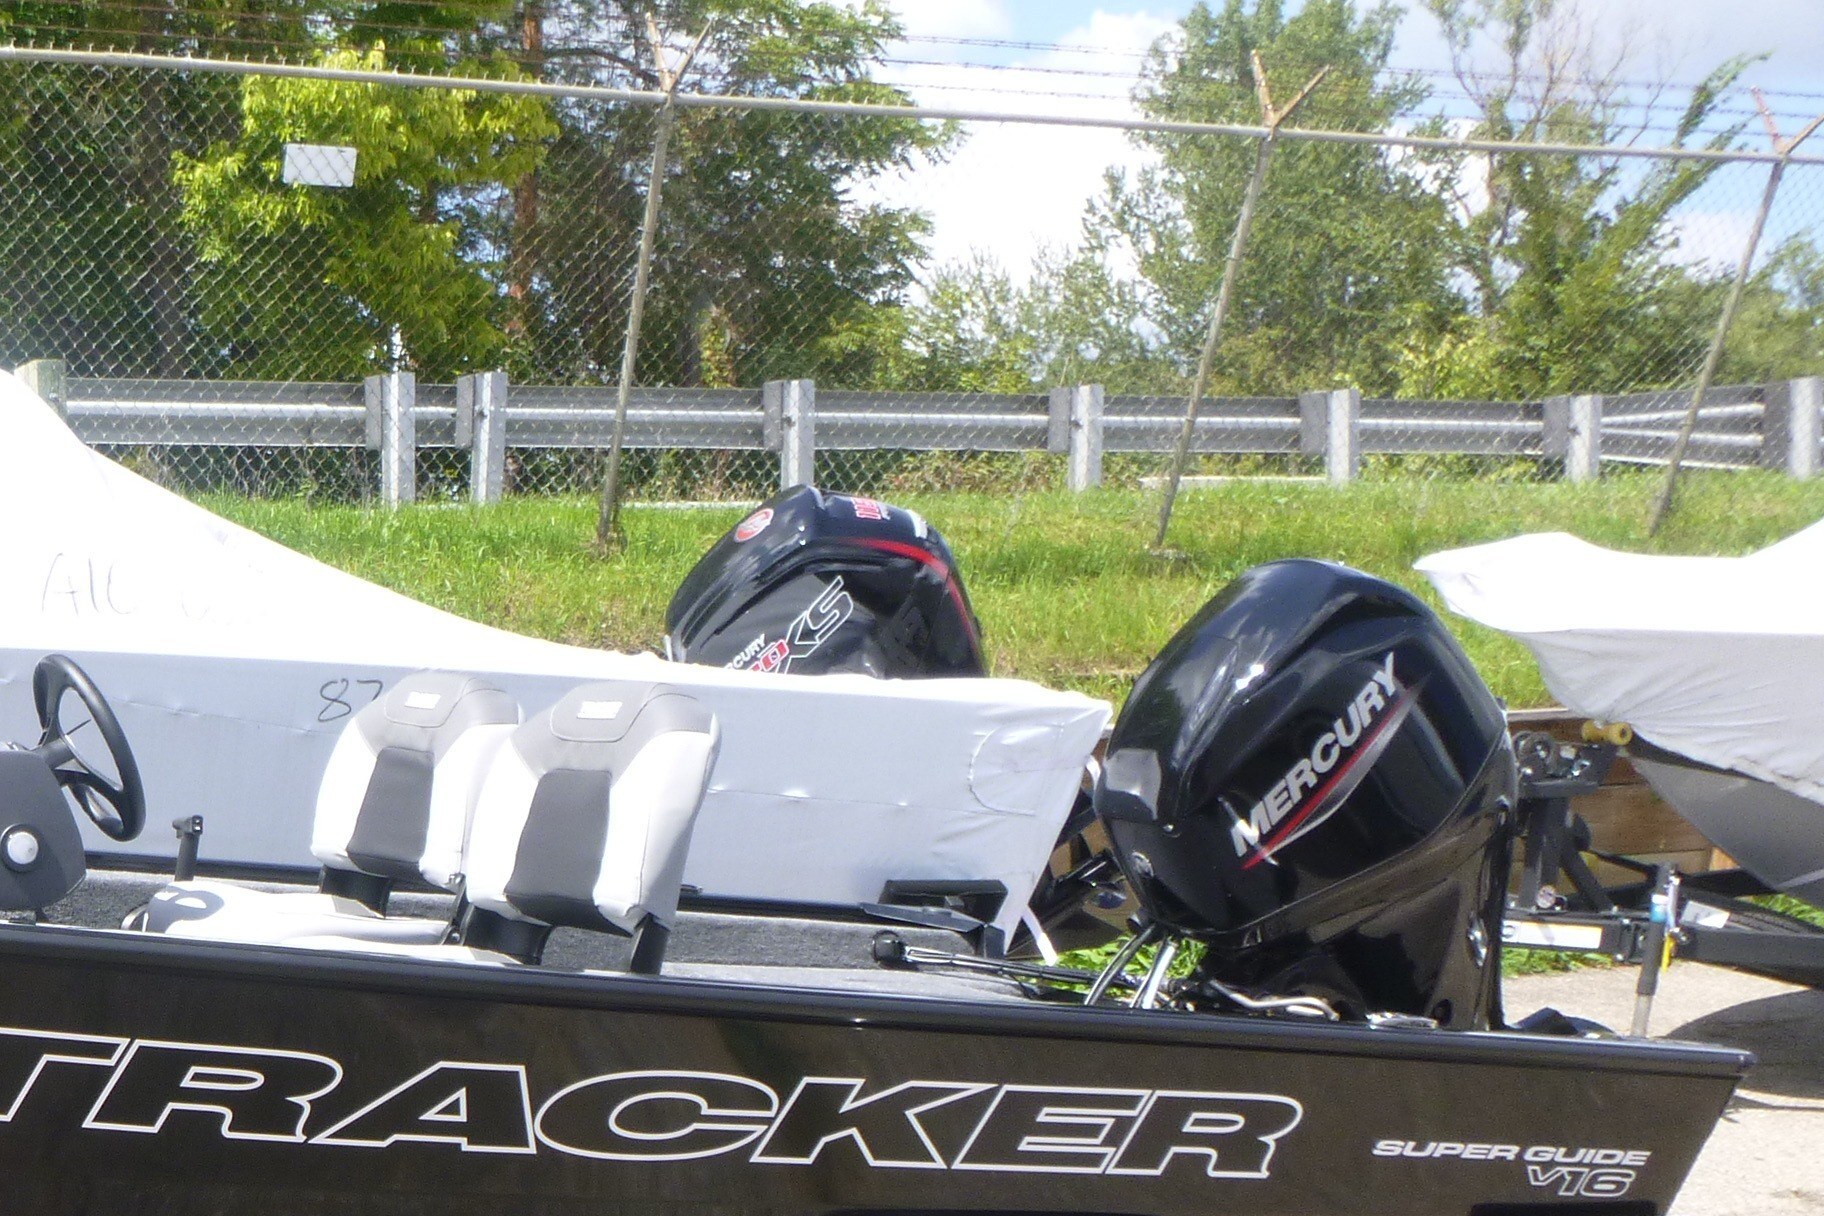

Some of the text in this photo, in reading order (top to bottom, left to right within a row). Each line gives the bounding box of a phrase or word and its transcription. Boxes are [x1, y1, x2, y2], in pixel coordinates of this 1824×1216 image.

[1230, 651, 1395, 858] MERCURY
[1372, 1139, 1652, 1166] SUPER GUIDE
[1526, 1165, 1636, 1198] V16
